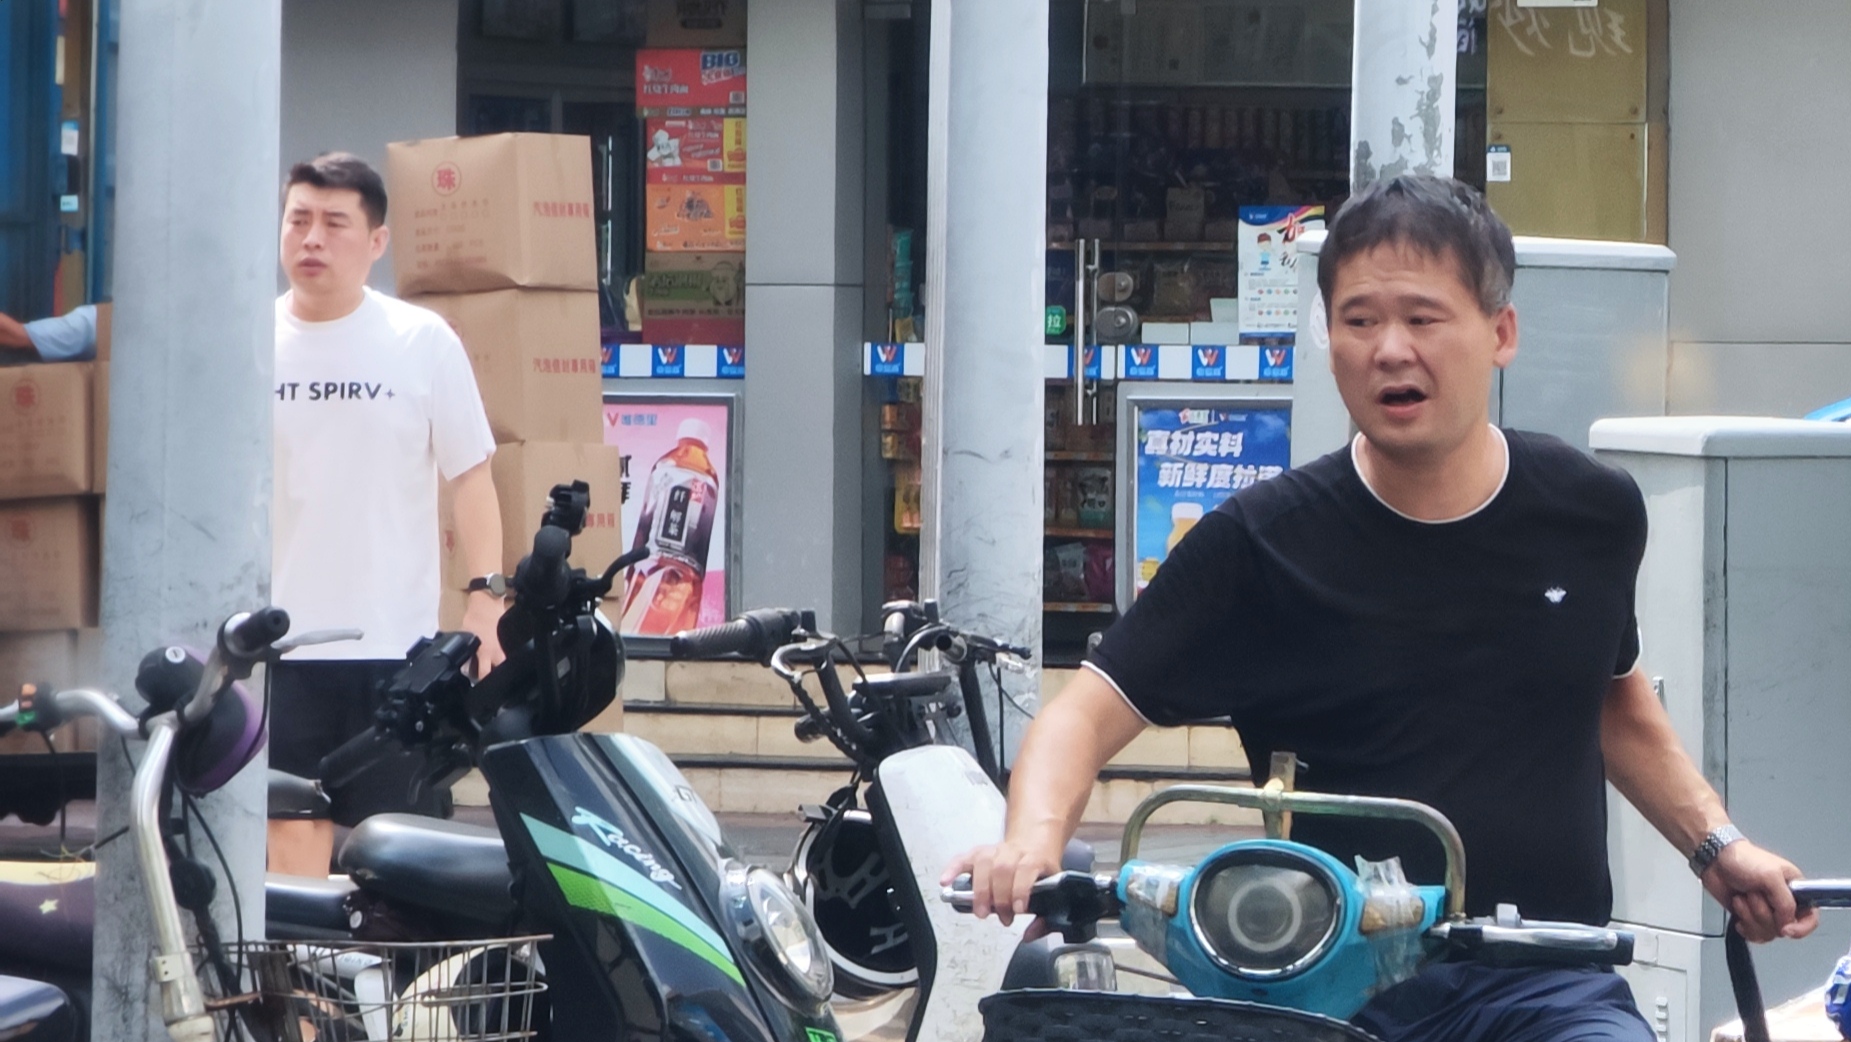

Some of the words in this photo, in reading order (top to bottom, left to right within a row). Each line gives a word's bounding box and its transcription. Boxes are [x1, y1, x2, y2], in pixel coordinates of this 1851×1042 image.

[308, 381, 382, 401] SPIRV
[1145, 429, 1244, 458] 真材实料
[571, 806, 682, 891] Racing
